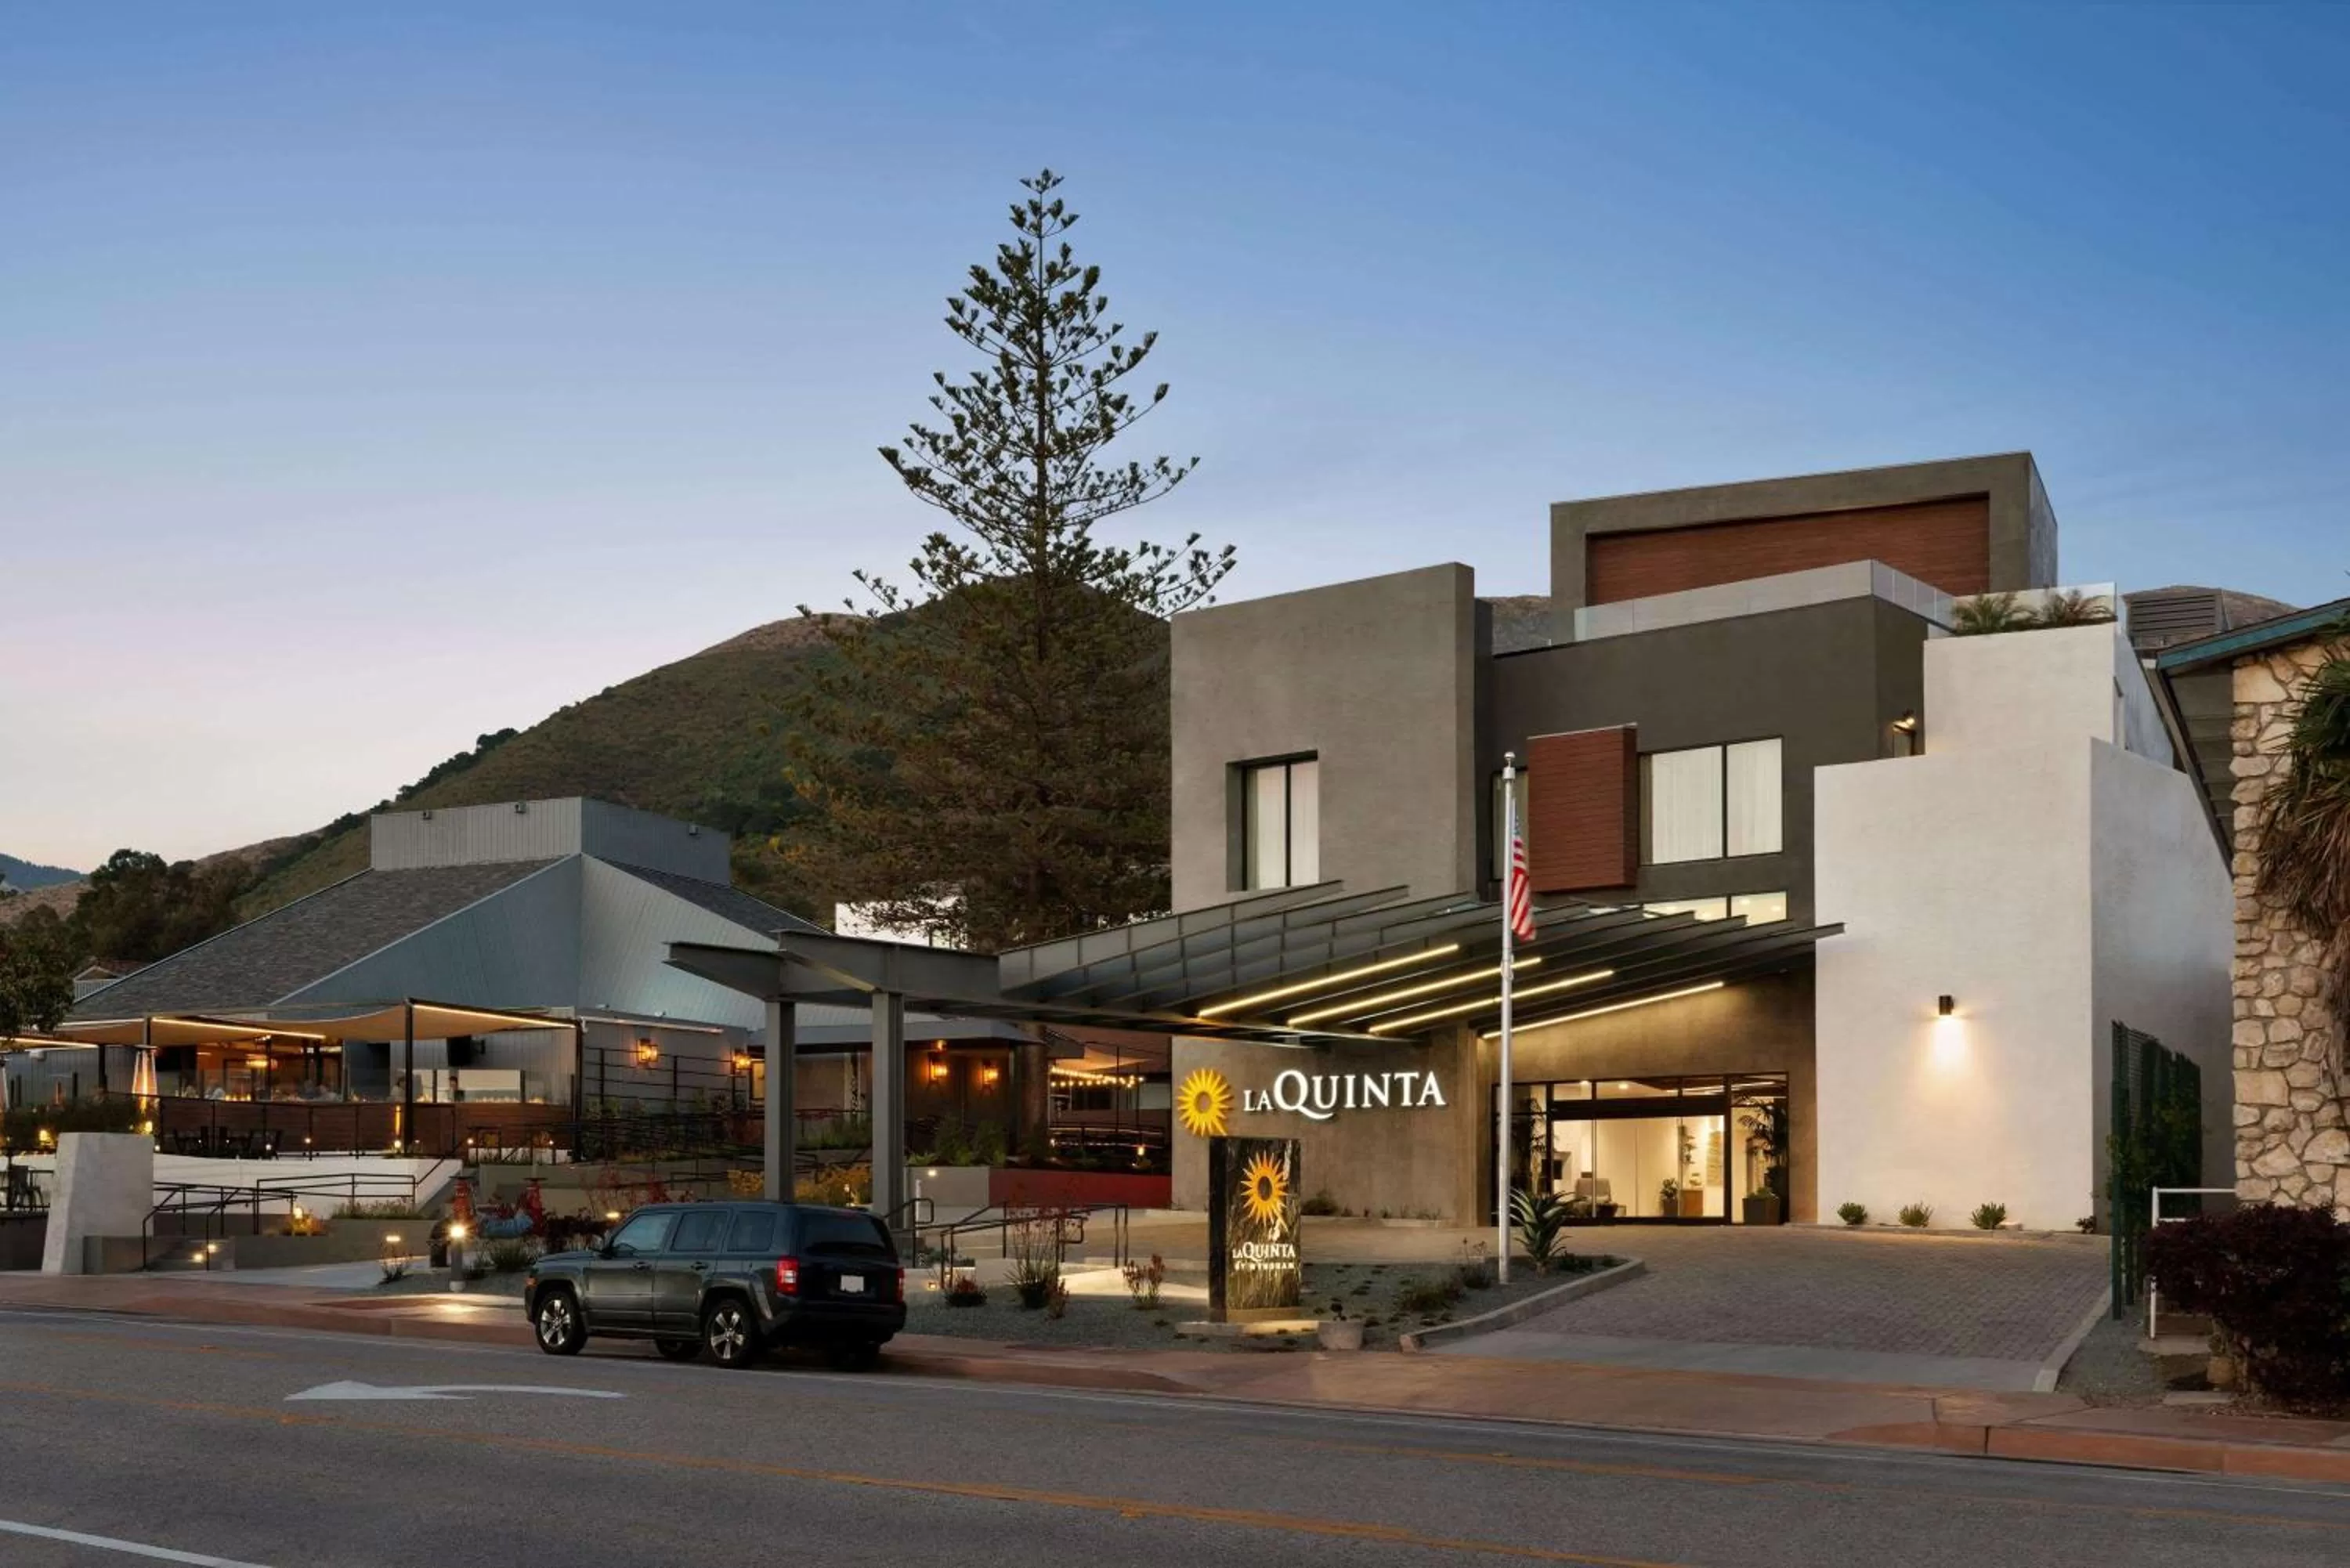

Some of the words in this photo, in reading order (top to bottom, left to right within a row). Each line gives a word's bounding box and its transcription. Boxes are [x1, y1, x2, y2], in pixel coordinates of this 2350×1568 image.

[1243, 1089, 1273, 1111] LA
[1274, 1069, 1446, 1120] QUINTA
[1242, 1241, 1296, 1262] QUINTA
